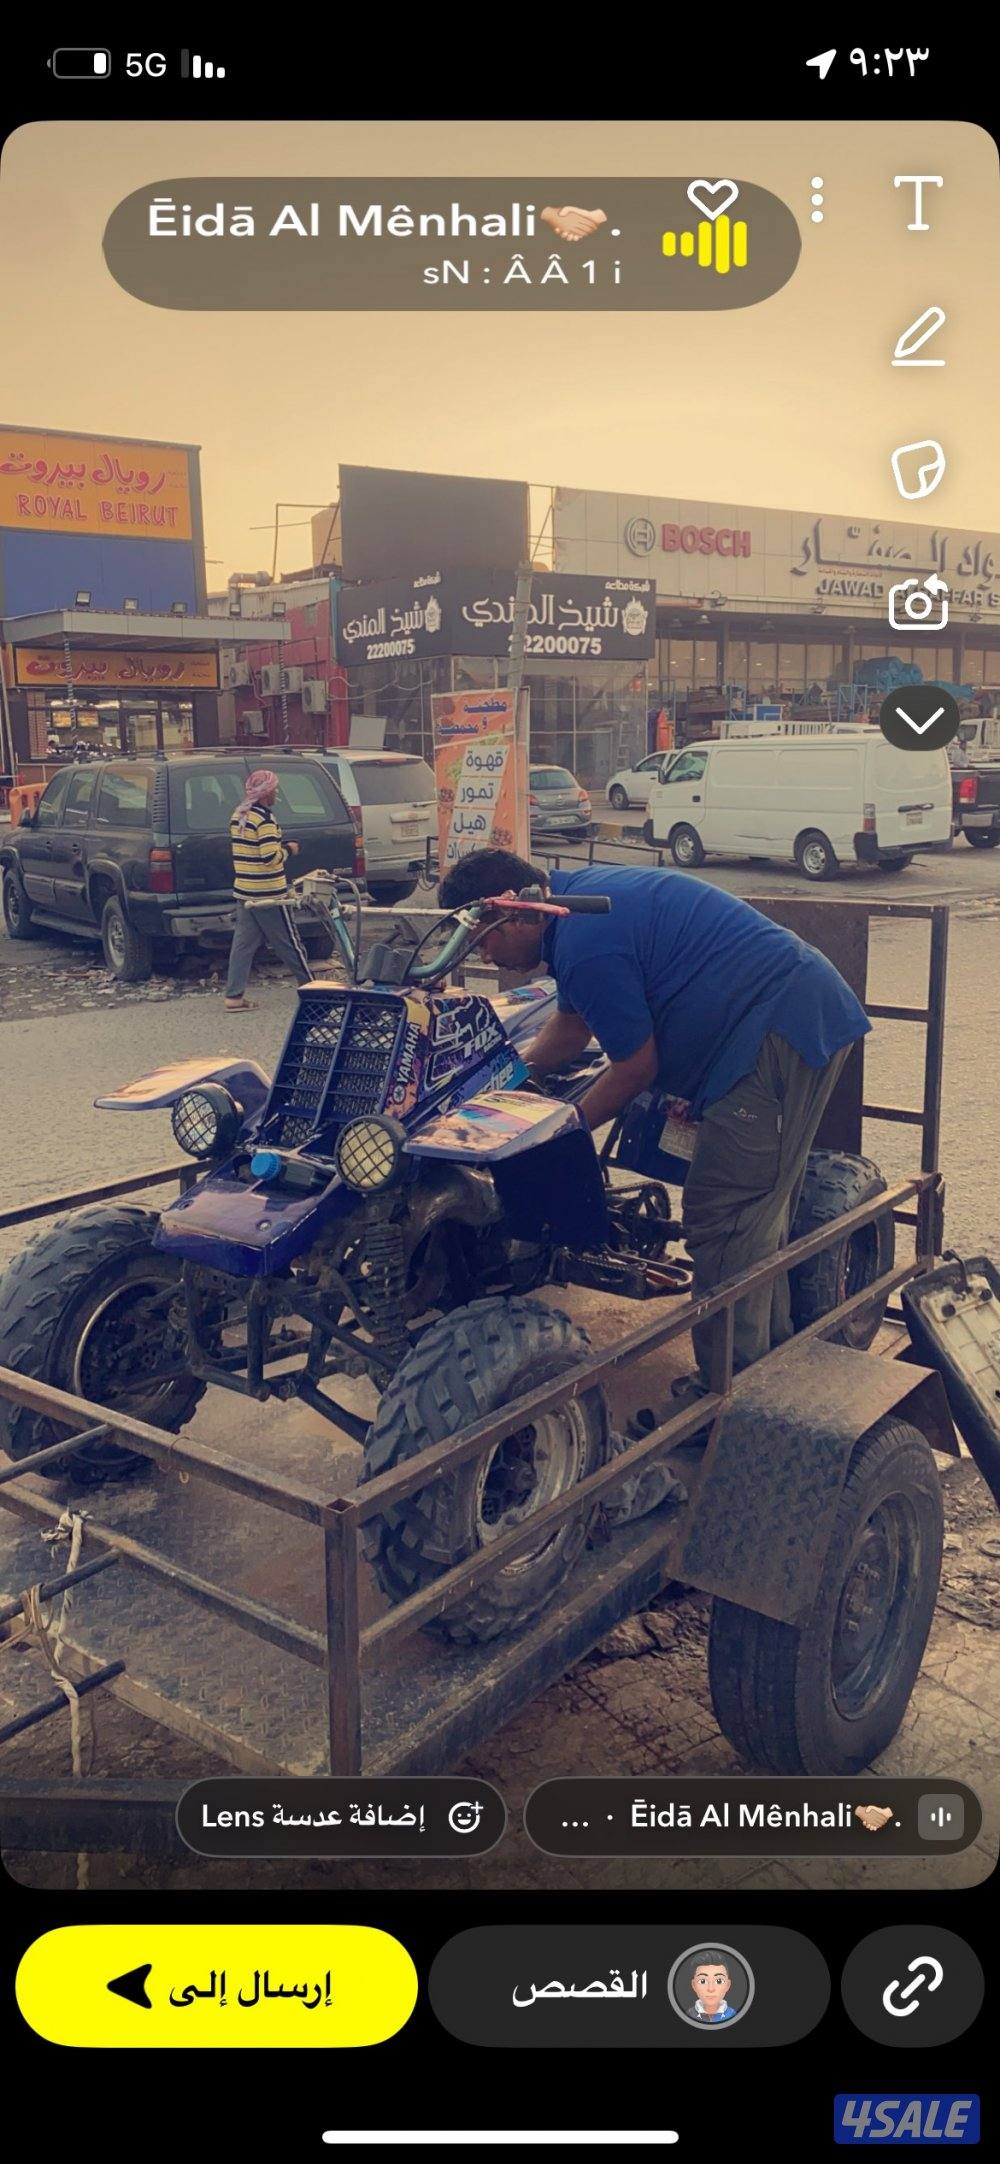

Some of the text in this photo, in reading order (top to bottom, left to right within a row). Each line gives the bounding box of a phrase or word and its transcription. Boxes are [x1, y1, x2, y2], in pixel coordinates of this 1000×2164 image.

[0, 452, 86, 489] بيروت
[90, 454, 166, 496] رويال
[17, 494, 179, 528] ROYAL BEIRUT
[661, 523, 752, 559] BOSCH
[816, 579, 884, 599] JAWAD
[342, 600, 426, 643] شيخ المندي
[558, 596, 620, 633] شيخ
[366, 638, 416, 660] 22200075
[118, 655, 186, 682] رويال
[465, 750, 504, 772] قهوة
[460, 782, 495, 803] تمور
[453, 812, 487, 835] هيل
[396, 1021, 421, 1084] YAMAHA
